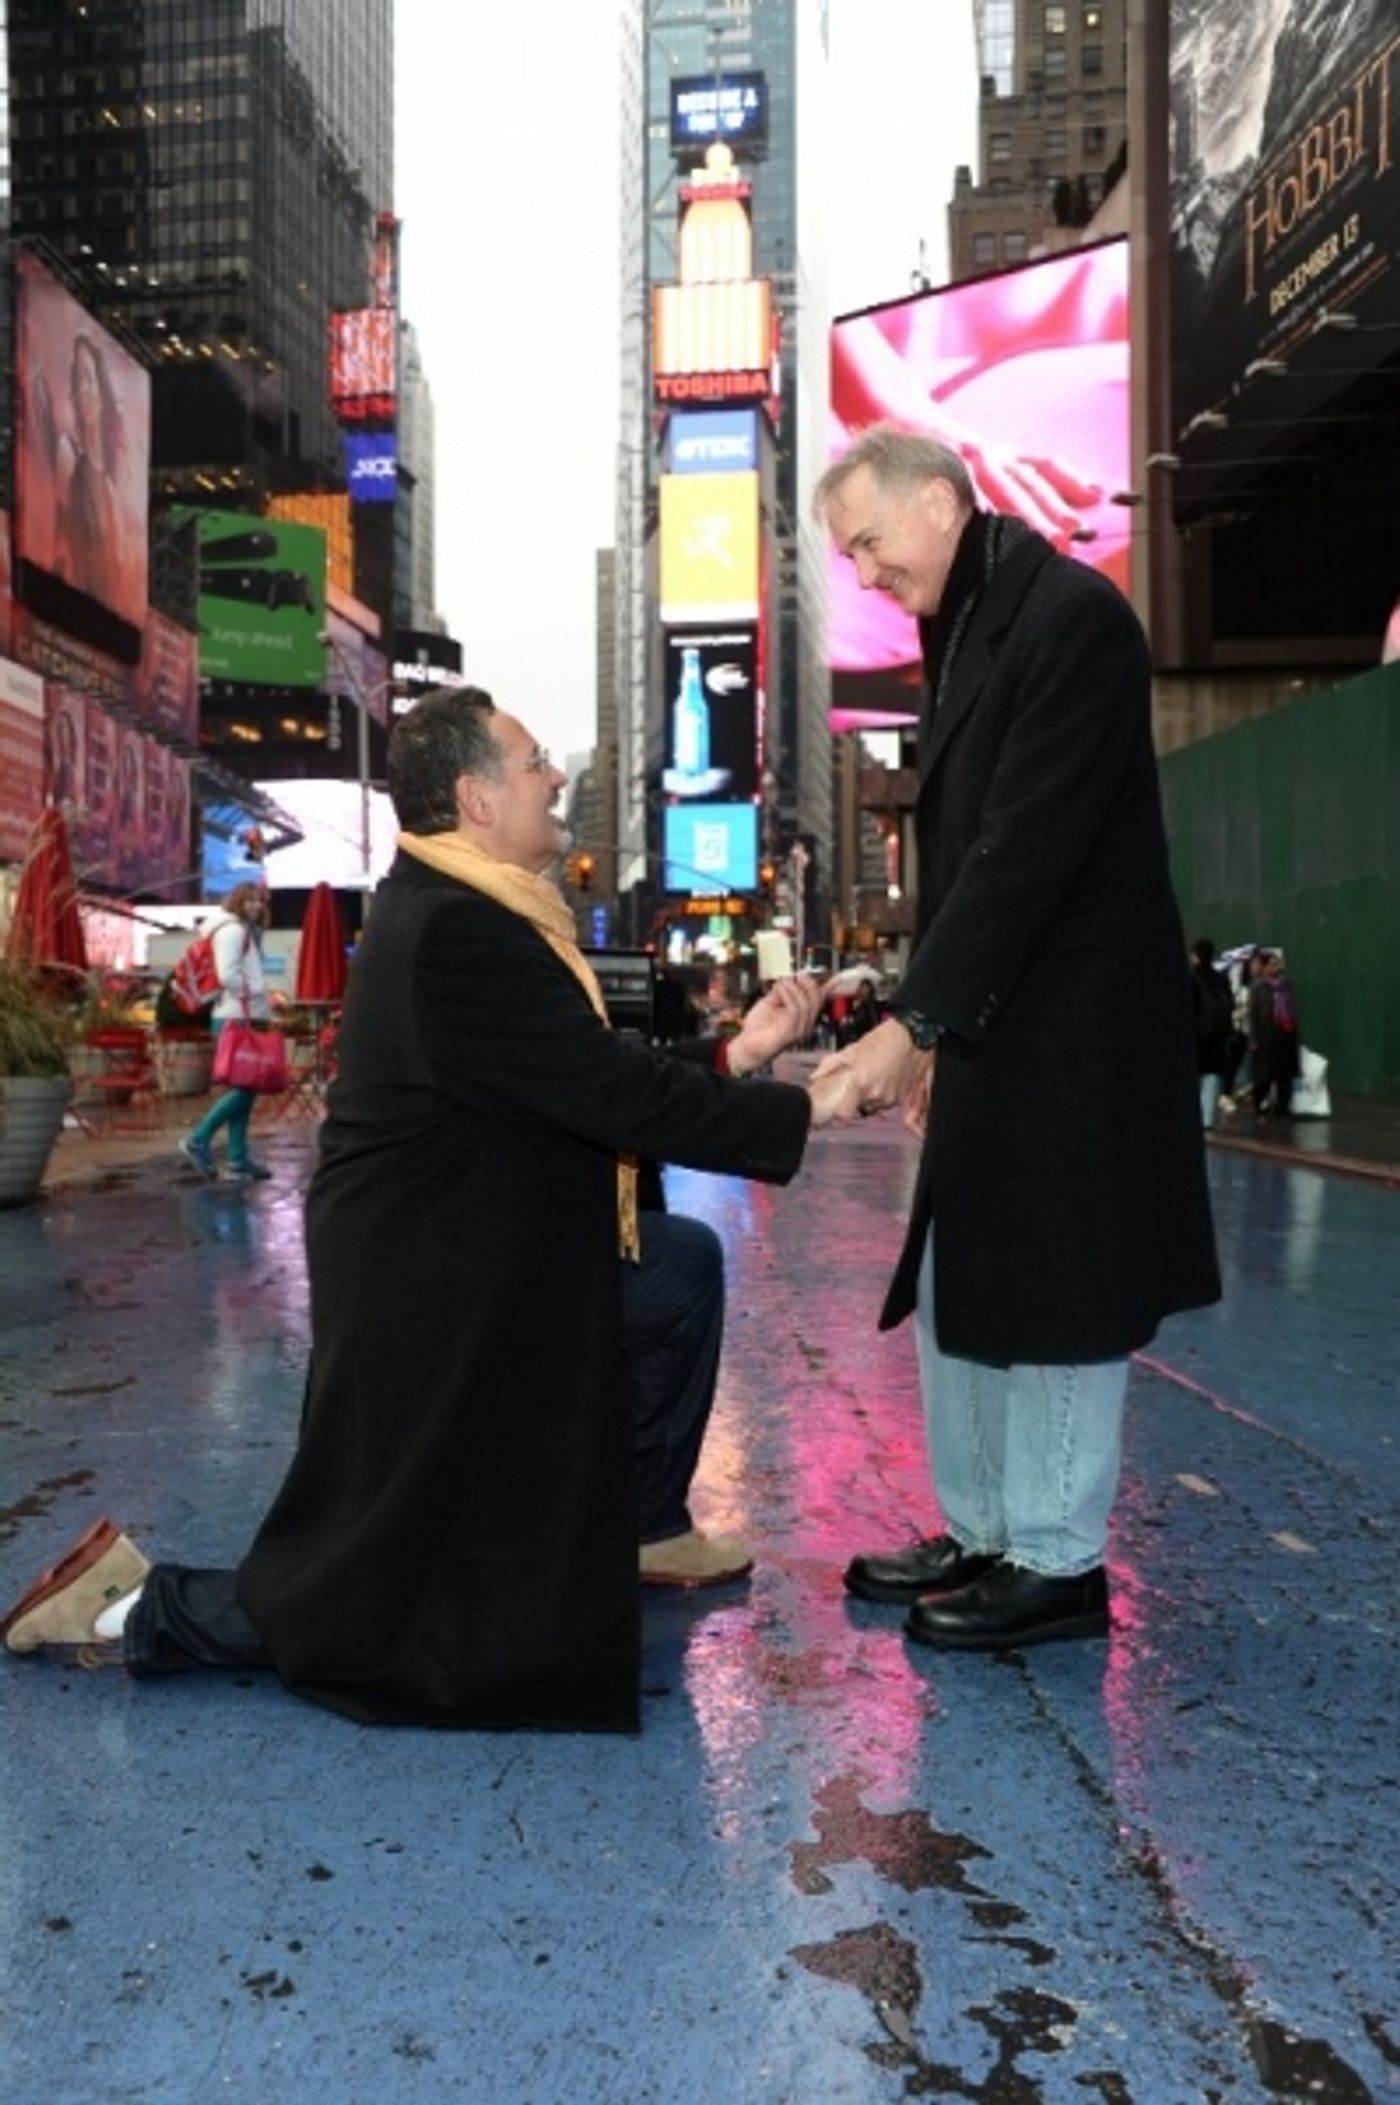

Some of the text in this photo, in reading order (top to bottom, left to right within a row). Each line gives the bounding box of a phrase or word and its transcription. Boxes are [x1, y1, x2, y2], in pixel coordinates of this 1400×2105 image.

[1269, 232, 1340, 318] DECEMBER
[1342, 211, 1360, 249] 13
[655, 370, 769, 399] TOSHIBA
